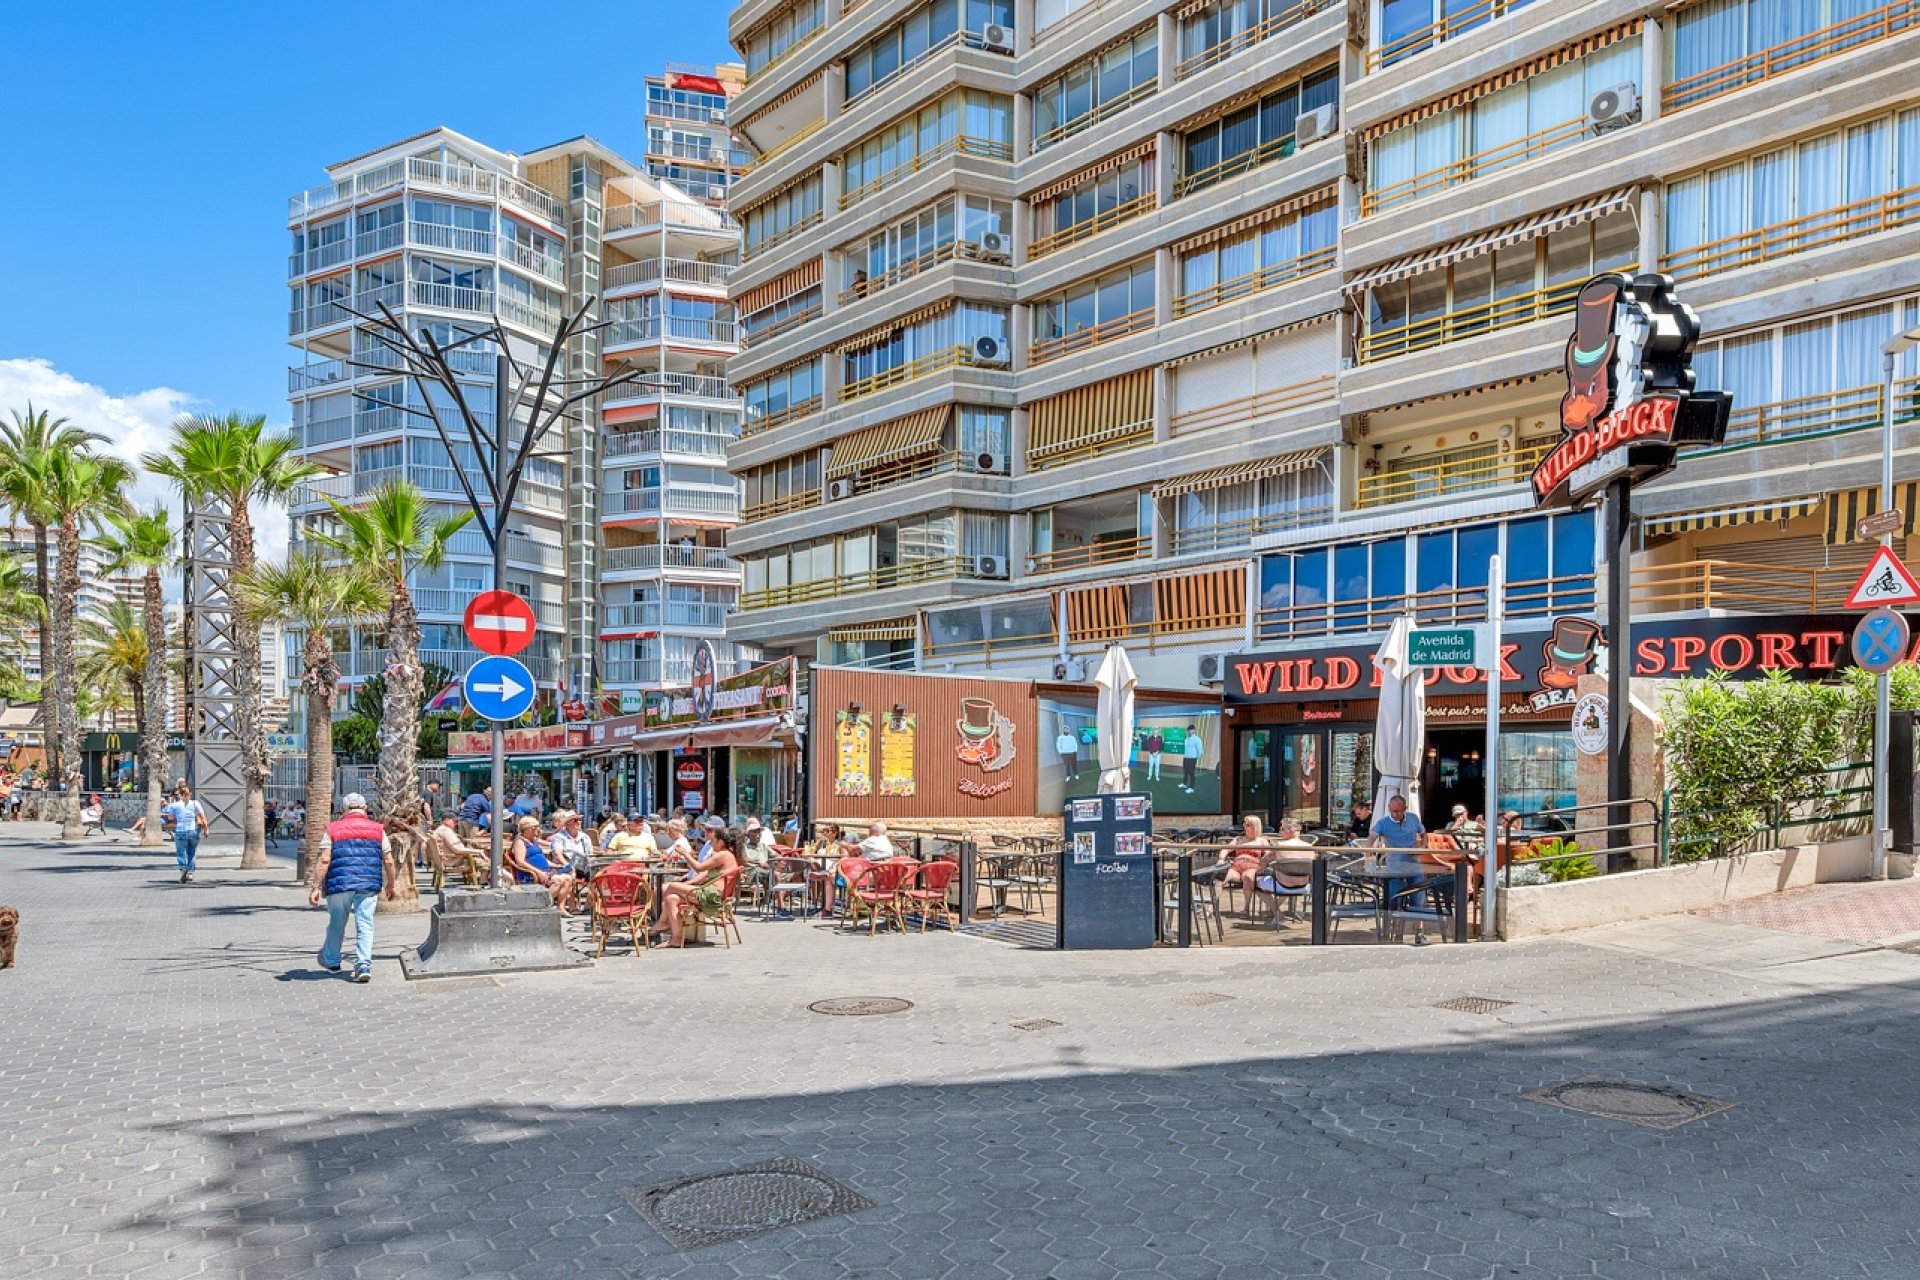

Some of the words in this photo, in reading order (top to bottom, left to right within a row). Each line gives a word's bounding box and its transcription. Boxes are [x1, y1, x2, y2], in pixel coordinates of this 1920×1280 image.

[1534, 431, 1591, 496] WILD
[1596, 398, 1672, 451] DUCK
[1418, 635, 1465, 646] Avenida
[1635, 630, 1844, 675] SPORT
[1412, 651, 1427, 661] de
[1430, 649, 1471, 661] Madrid
[1234, 656, 1360, 695] WILD
[1448, 704, 1470, 718] pub
